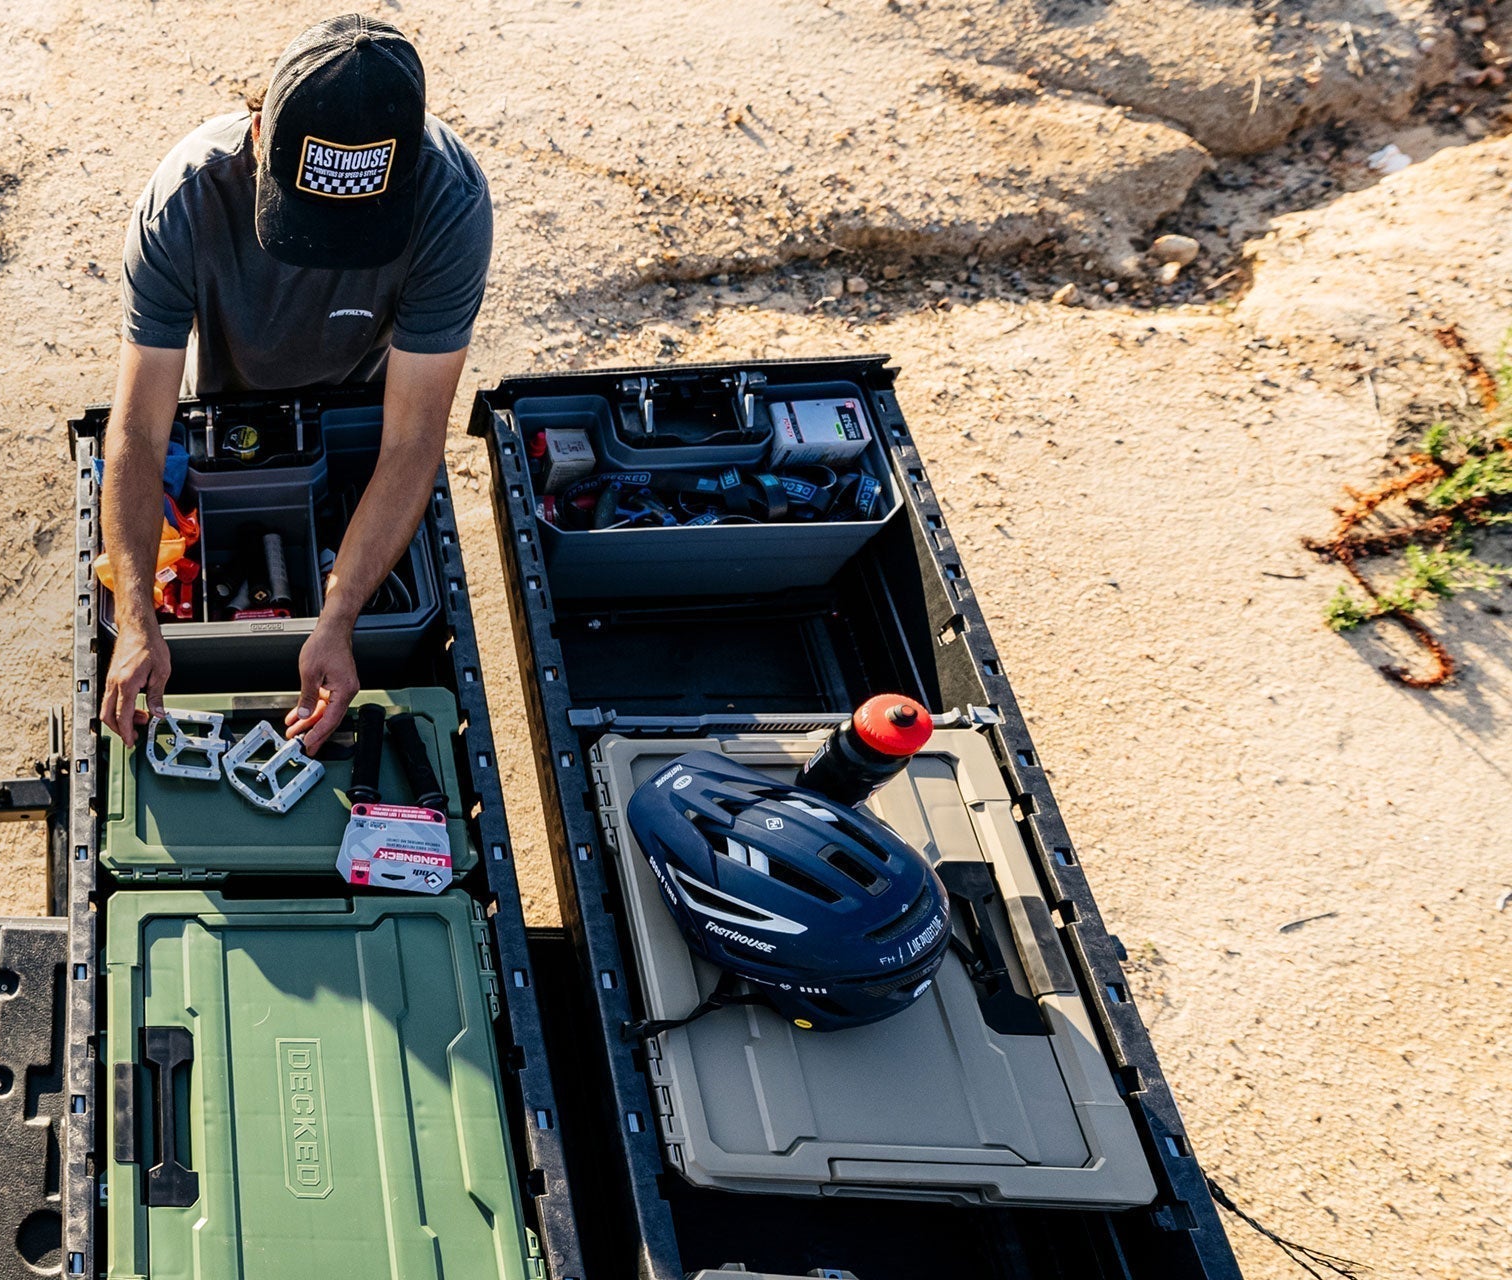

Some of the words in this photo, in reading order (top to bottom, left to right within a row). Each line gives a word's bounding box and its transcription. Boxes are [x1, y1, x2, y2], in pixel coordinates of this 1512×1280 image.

[306, 143, 391, 171] FASTHOUSE
[601, 473, 648, 483] DECKED
[378, 850, 446, 866] LONGNECK
[704, 920, 777, 954] FASTHOUSE
[288, 1049, 321, 1187] DECKED
